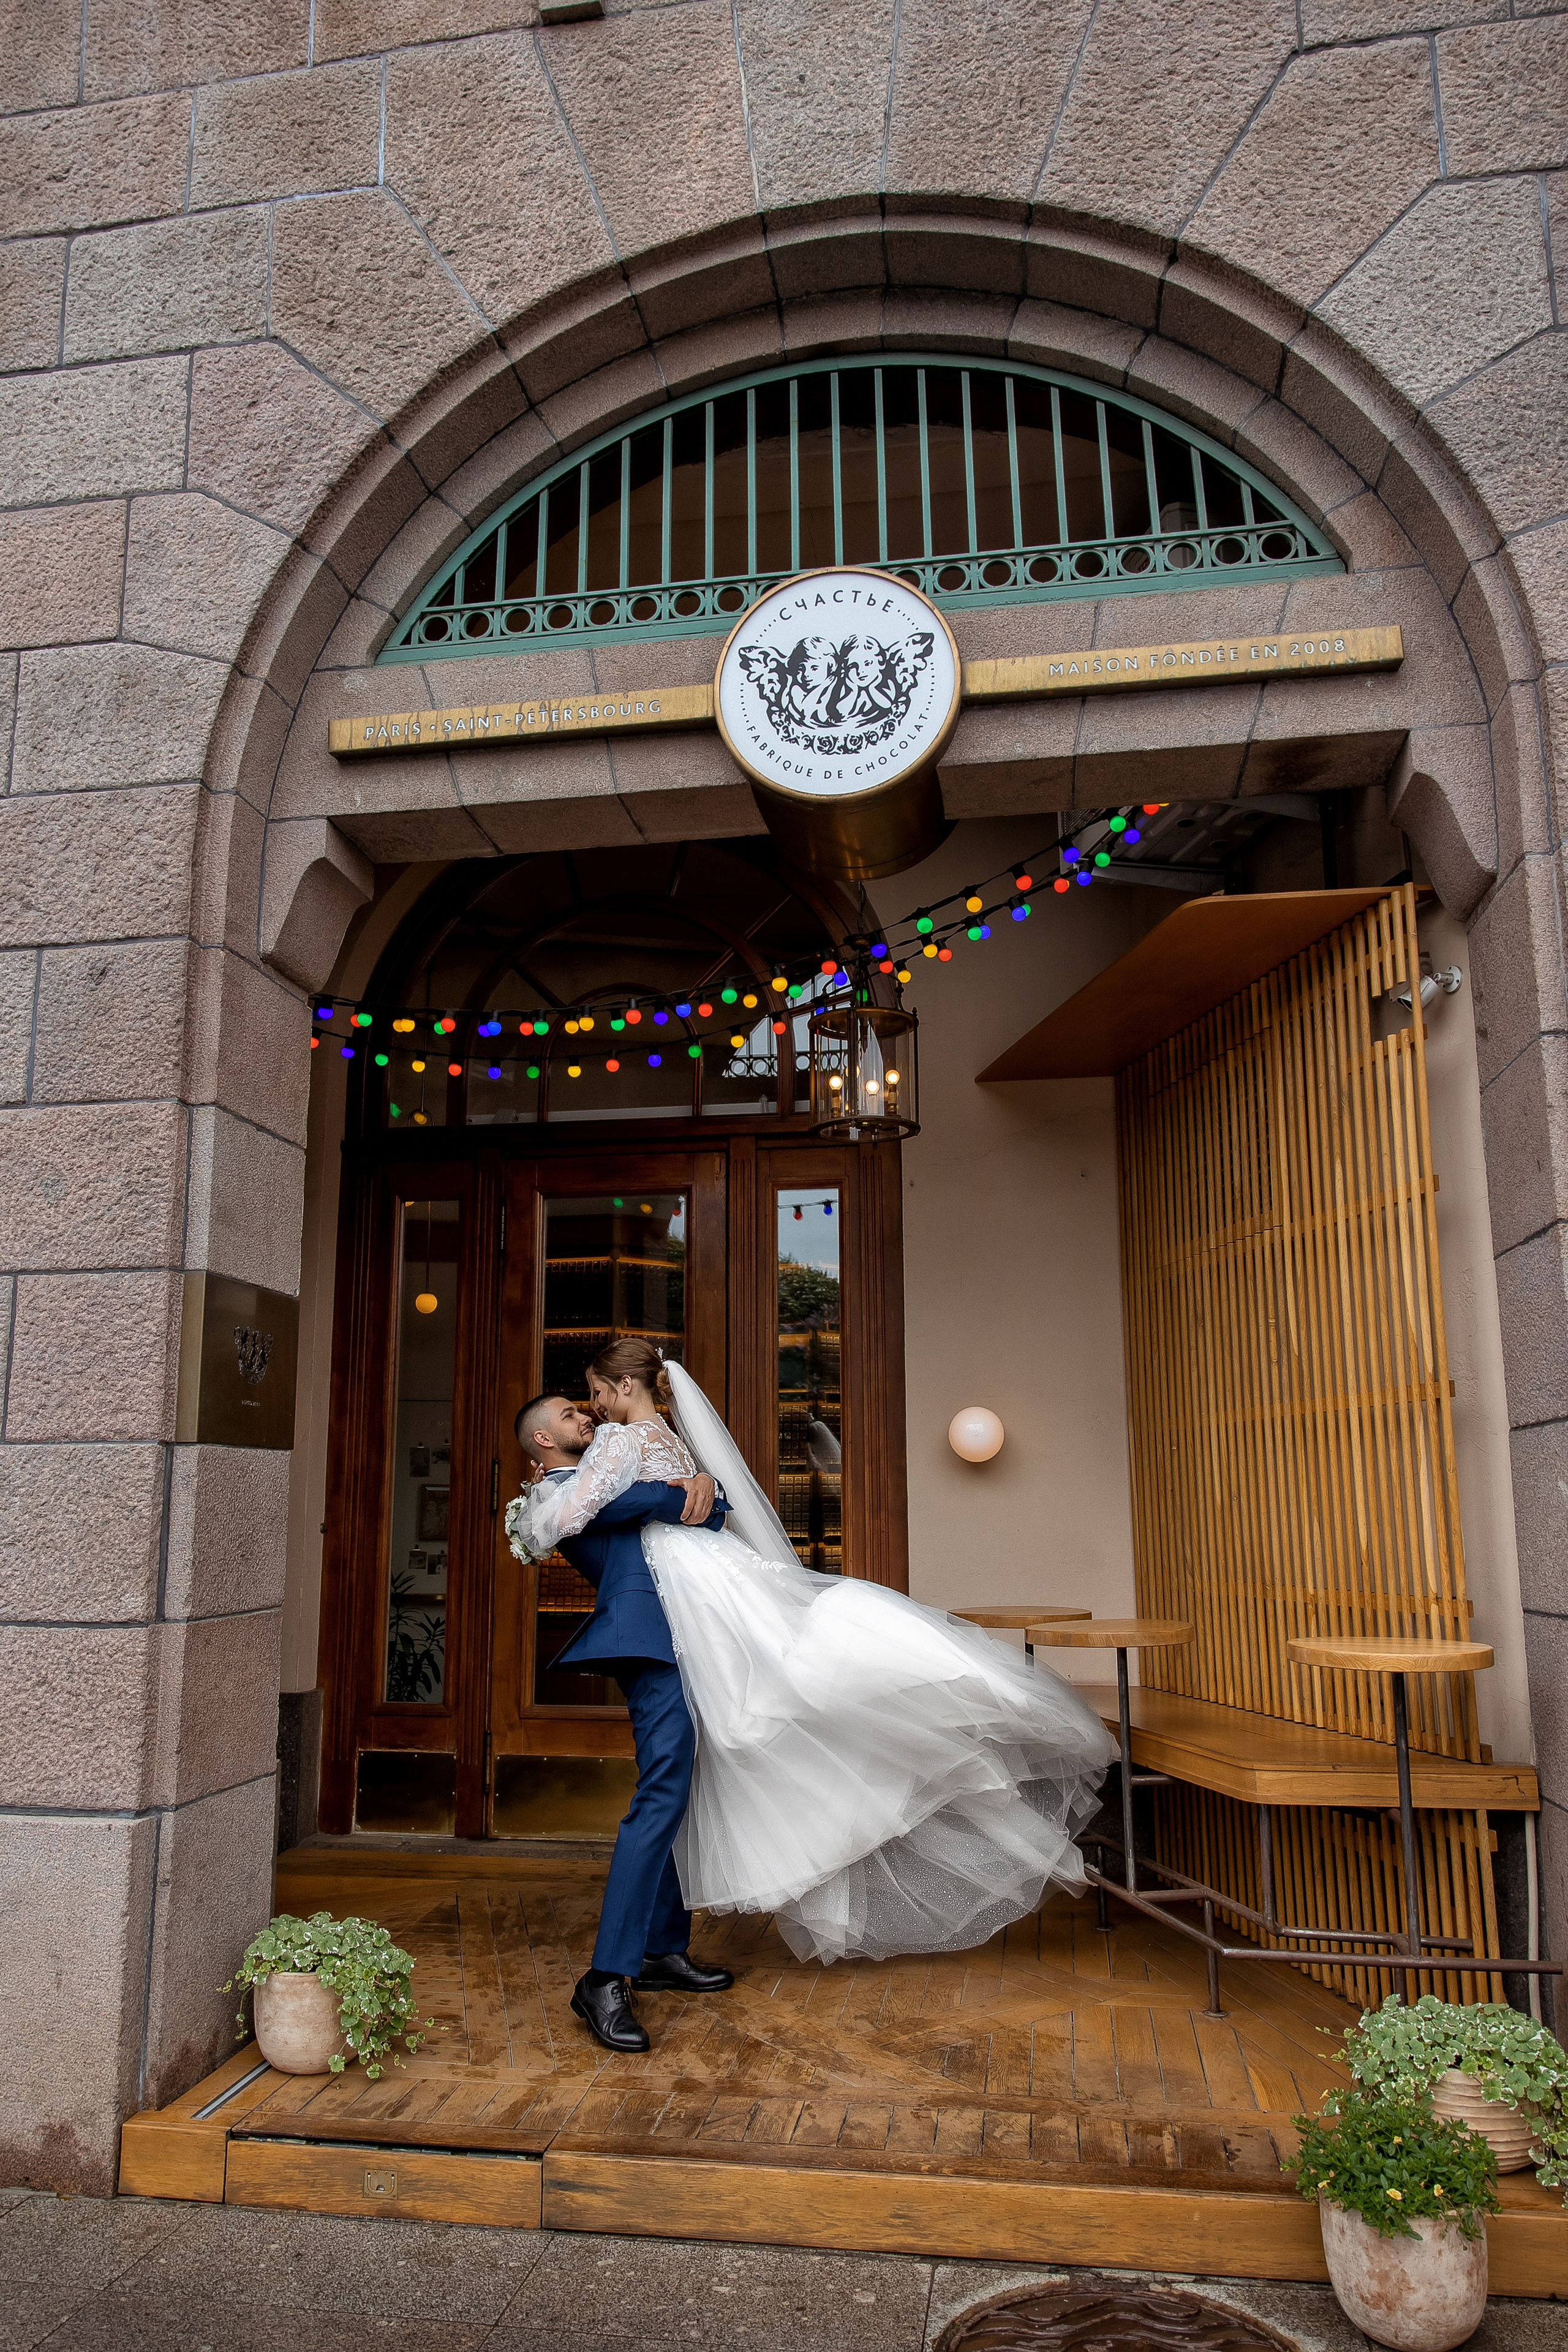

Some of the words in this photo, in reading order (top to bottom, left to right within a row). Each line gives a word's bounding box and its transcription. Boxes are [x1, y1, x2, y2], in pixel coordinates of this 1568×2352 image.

[779, 590, 894, 621] СЧАСТЬЕ
[1049, 655, 1139, 677] MAISON
[1149, 644, 1239, 668] FONDÉE
[1250, 644, 1279, 660] EN
[1289, 638, 1345, 657] 2008
[365, 721, 421, 740] PARIS
[443, 699, 661, 733] SAINT-PÉTERSBOURG
[746, 725, 813, 778] FABRIQUE
[824, 769, 843, 780] DE
[854, 713, 929, 776] CHOCOLAT
